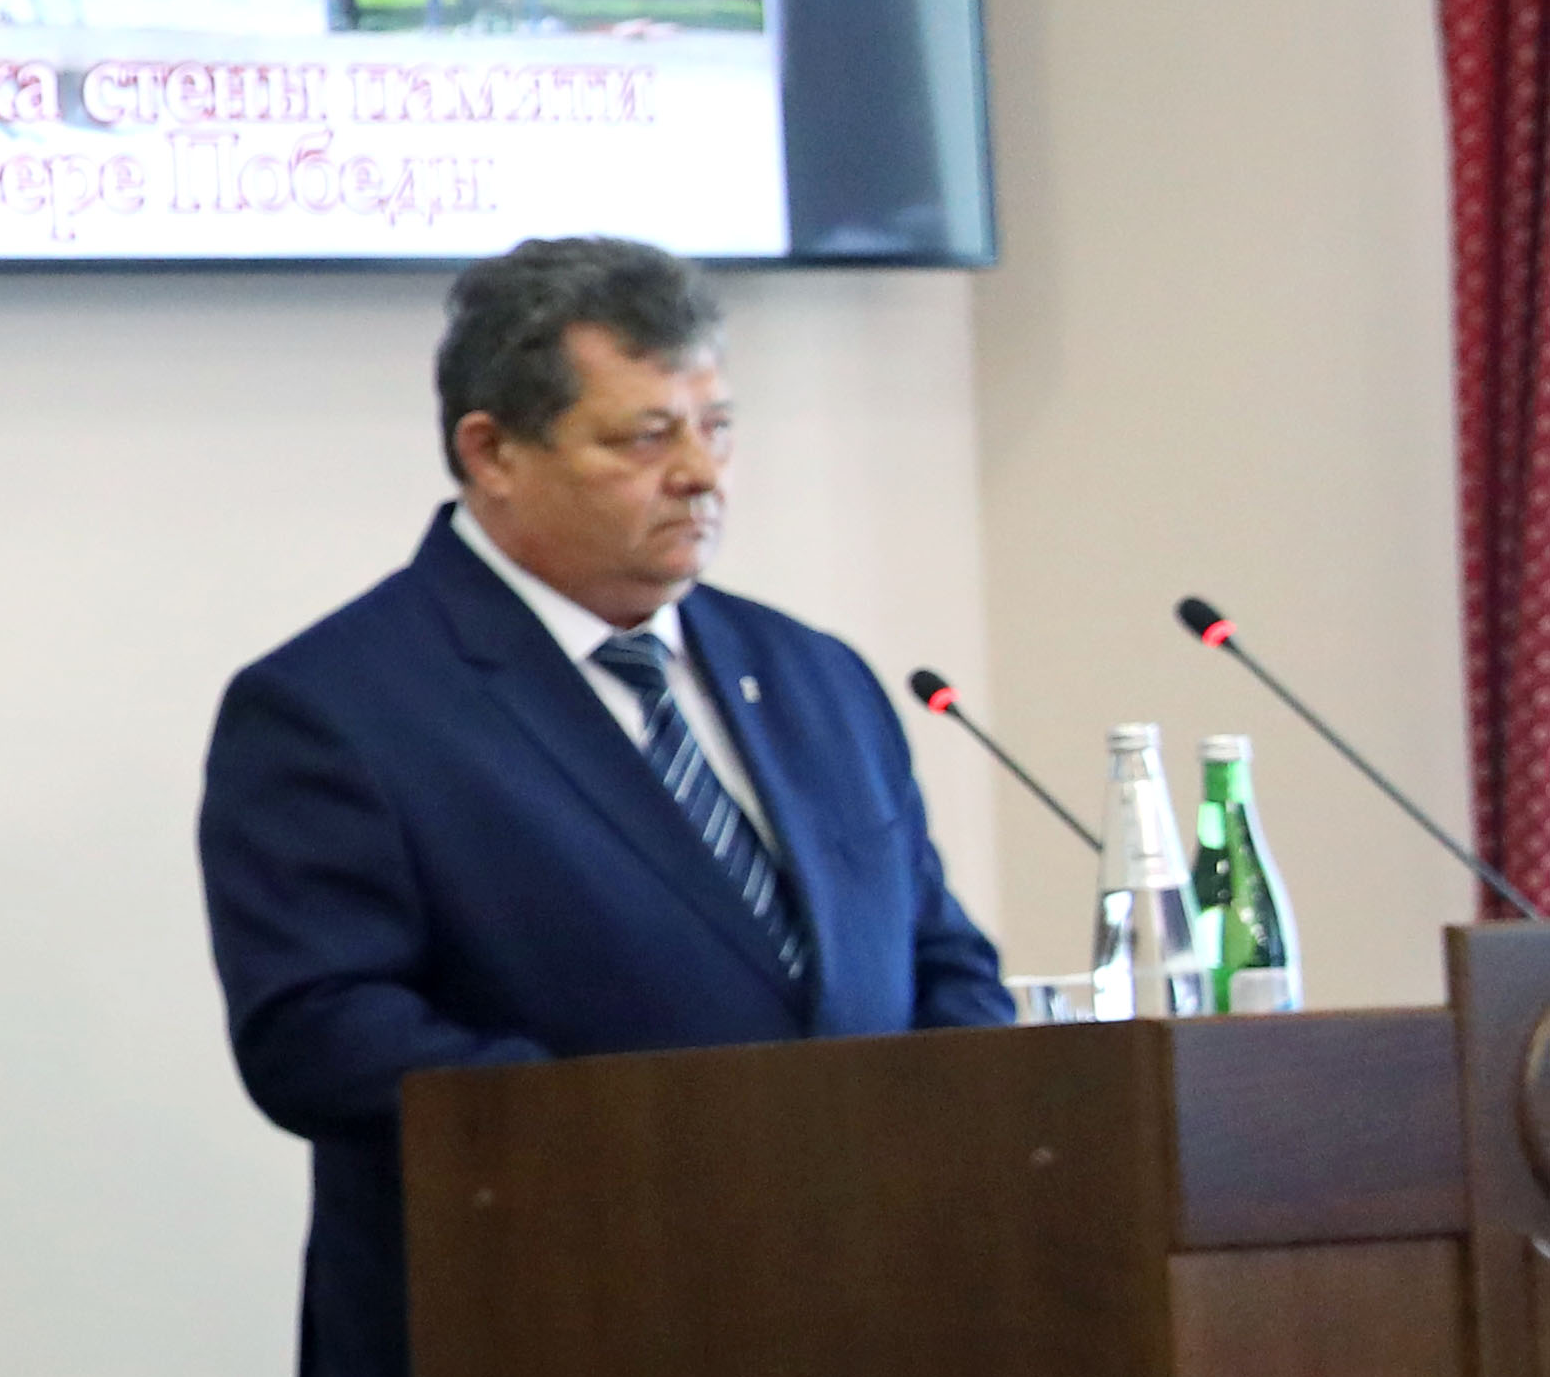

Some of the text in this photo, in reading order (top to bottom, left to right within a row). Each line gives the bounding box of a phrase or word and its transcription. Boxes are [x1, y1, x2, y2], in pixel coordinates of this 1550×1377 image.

[81, 59, 328, 124] стены
[351, 60, 656, 123] памяти
[165, 127, 497, 227] Победы
